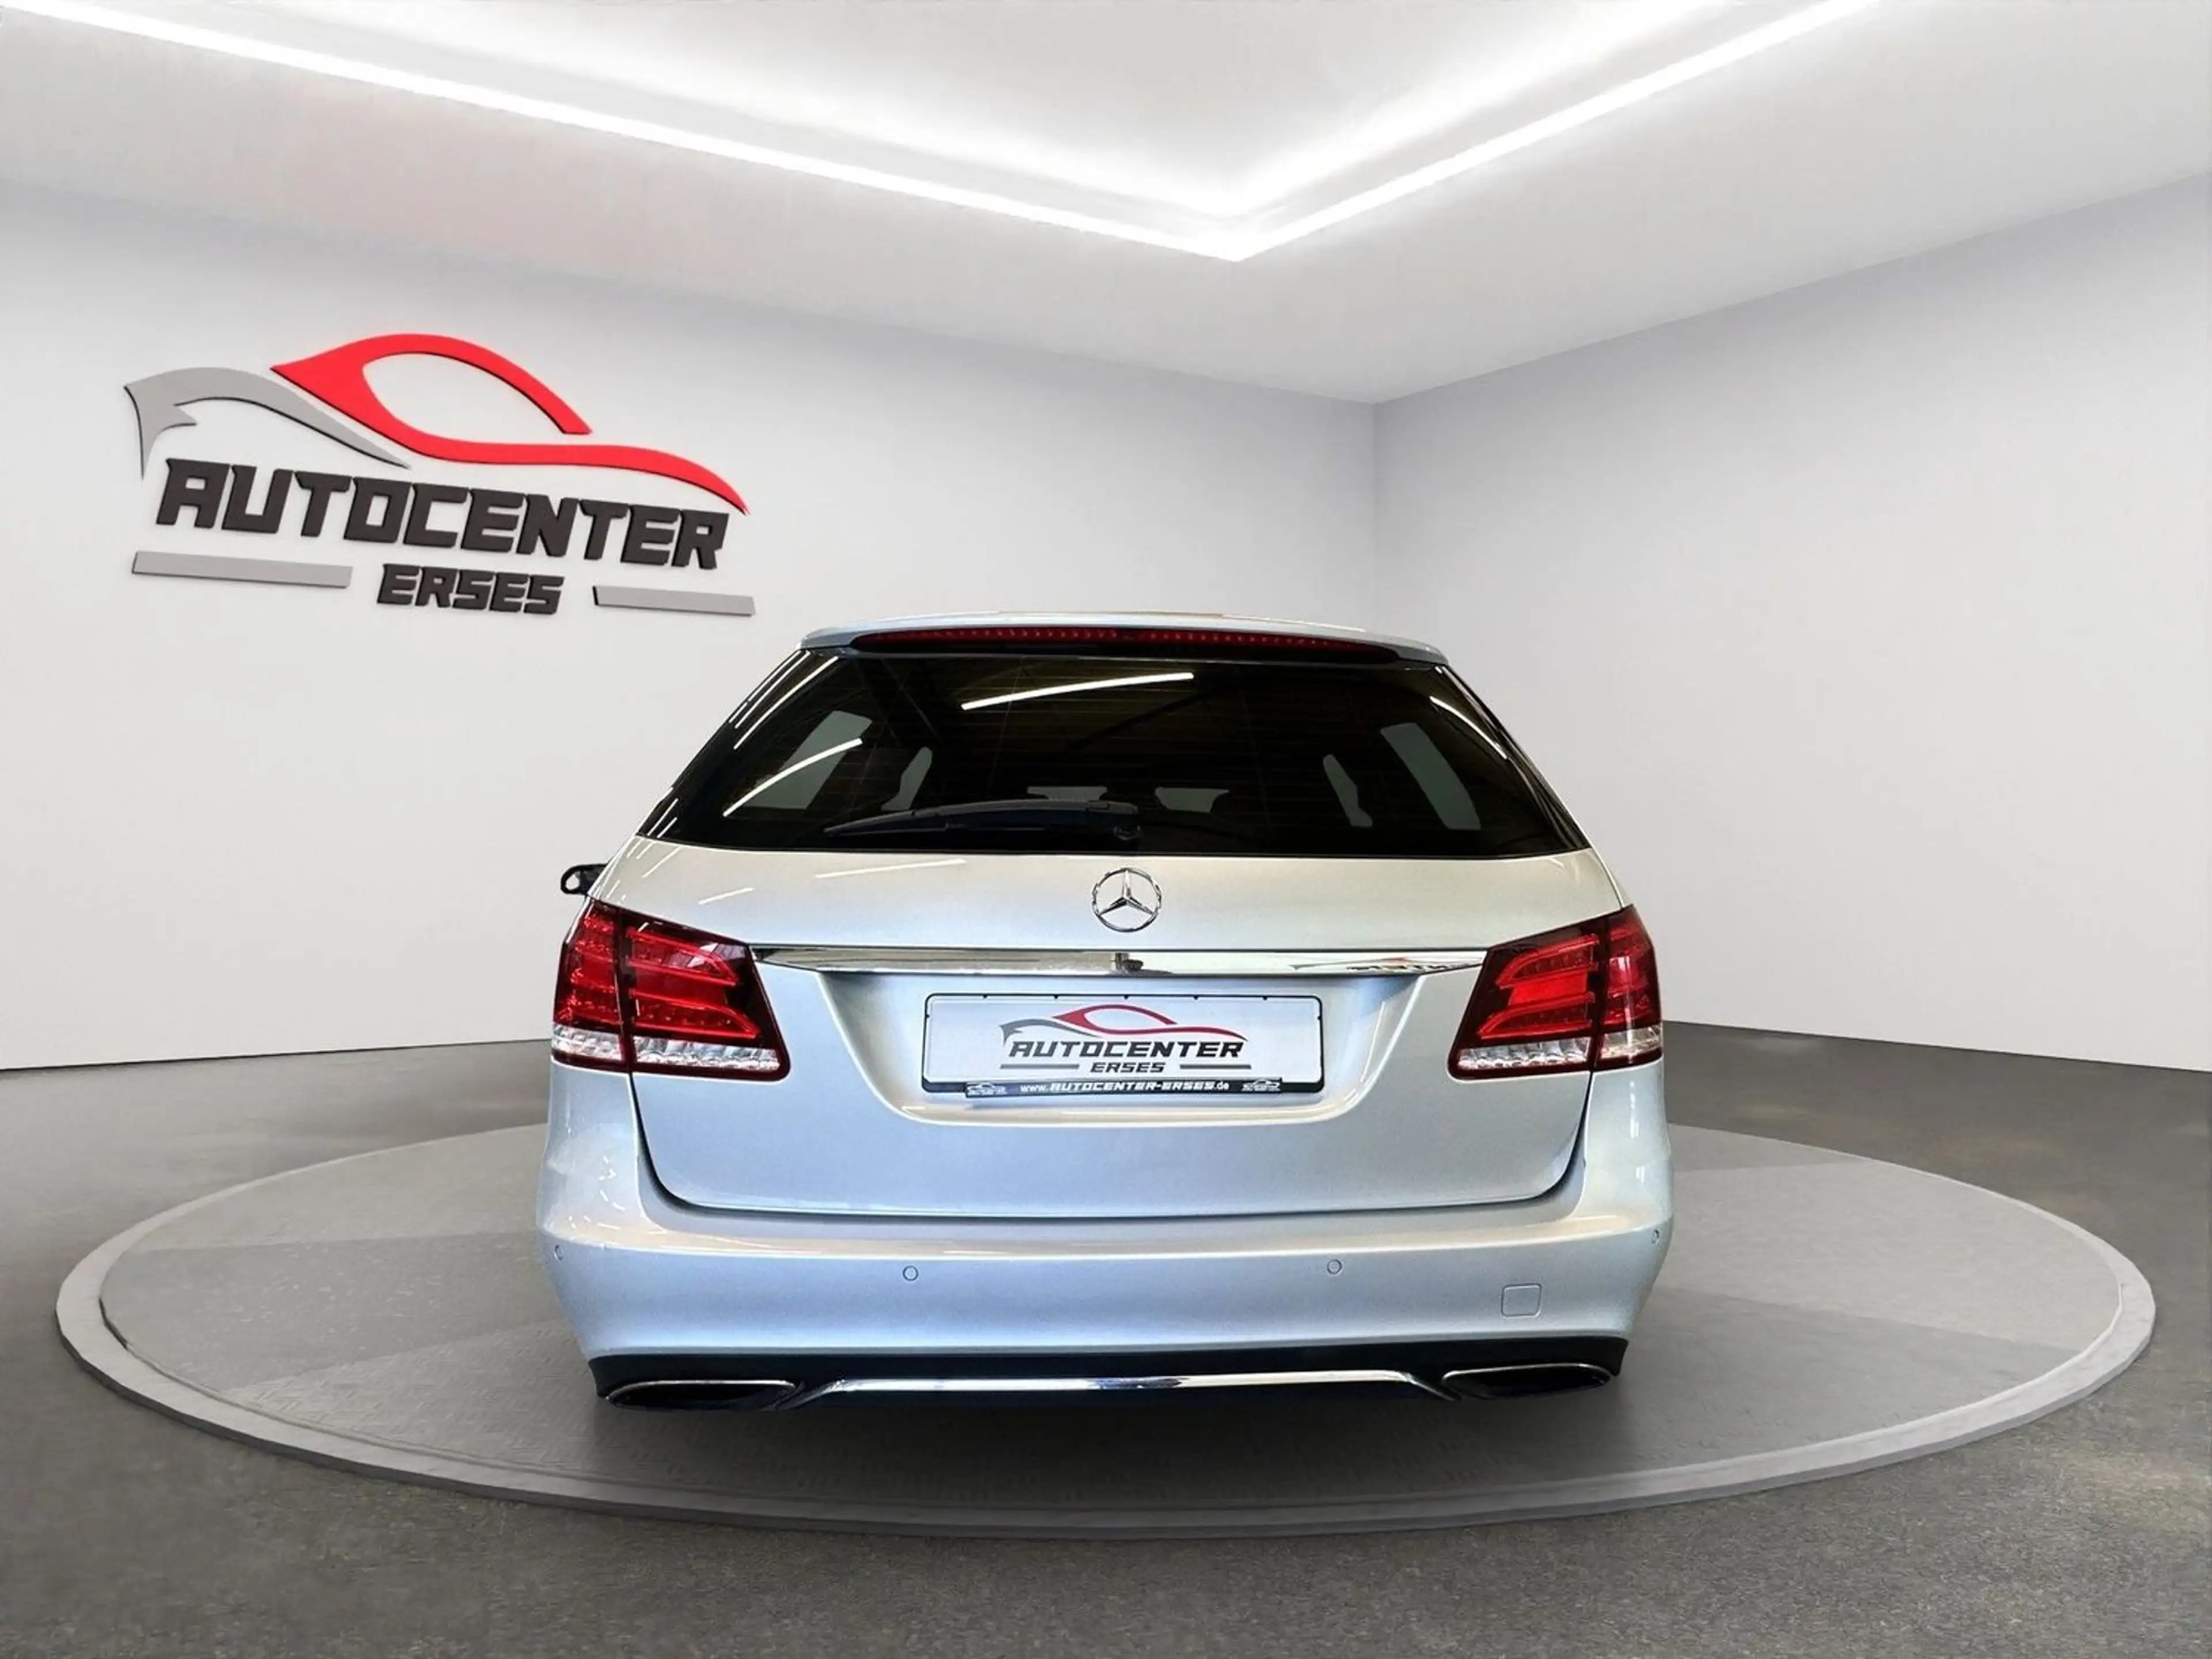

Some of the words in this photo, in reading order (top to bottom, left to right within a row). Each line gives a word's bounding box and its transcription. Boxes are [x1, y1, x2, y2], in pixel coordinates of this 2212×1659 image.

[156, 458, 729, 570] AUTOCENTER
[377, 563, 564, 615] ERSES
[1010, 1041, 1244, 1057] AUTOCENTER
[1090, 1062, 1165, 1073] ERSES
[1020, 1081, 1229, 1093] www.AUTOCENTER-ERSES.de
